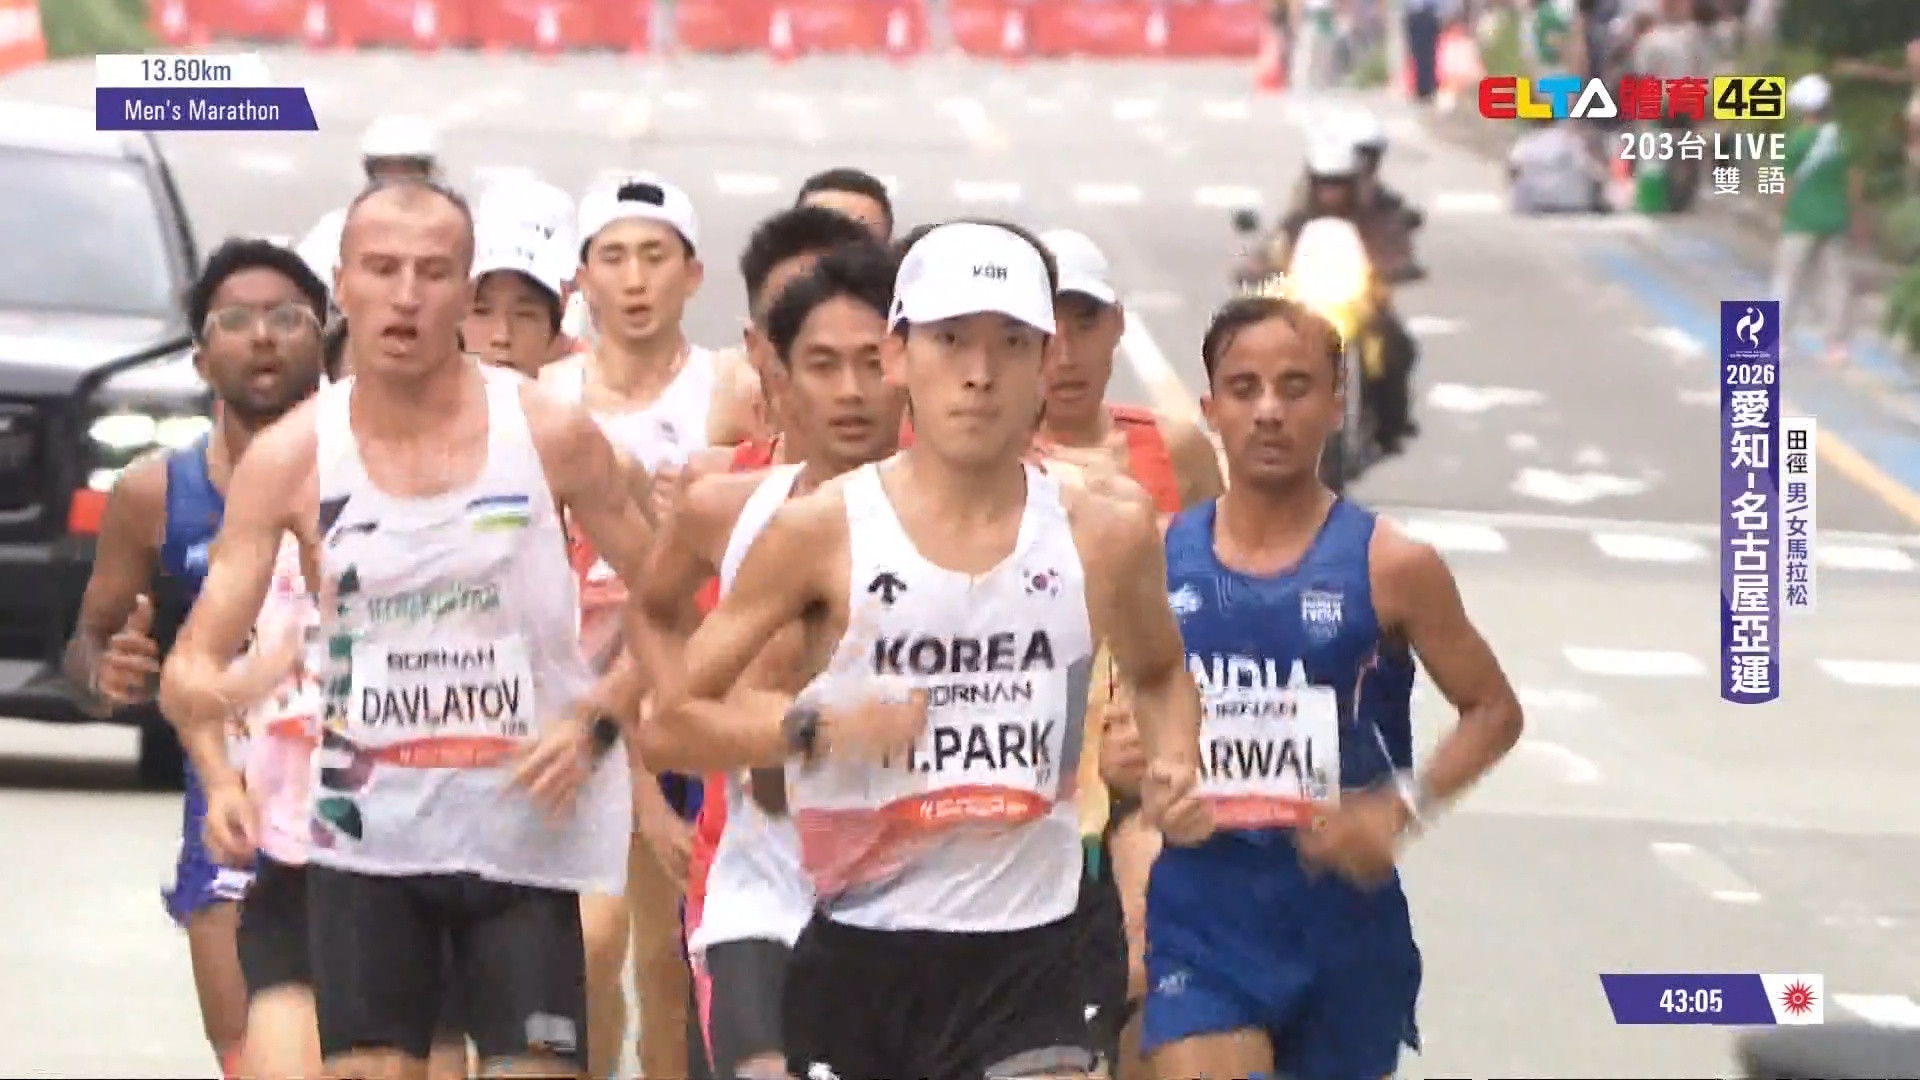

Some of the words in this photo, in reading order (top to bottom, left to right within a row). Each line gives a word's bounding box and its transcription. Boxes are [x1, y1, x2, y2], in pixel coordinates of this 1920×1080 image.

[872, 629, 1055, 676] KOREA
[1186, 652, 1310, 690] NDIA
[361, 673, 520, 727] DAVLATOV
[926, 679, 1034, 707] ORNAN
